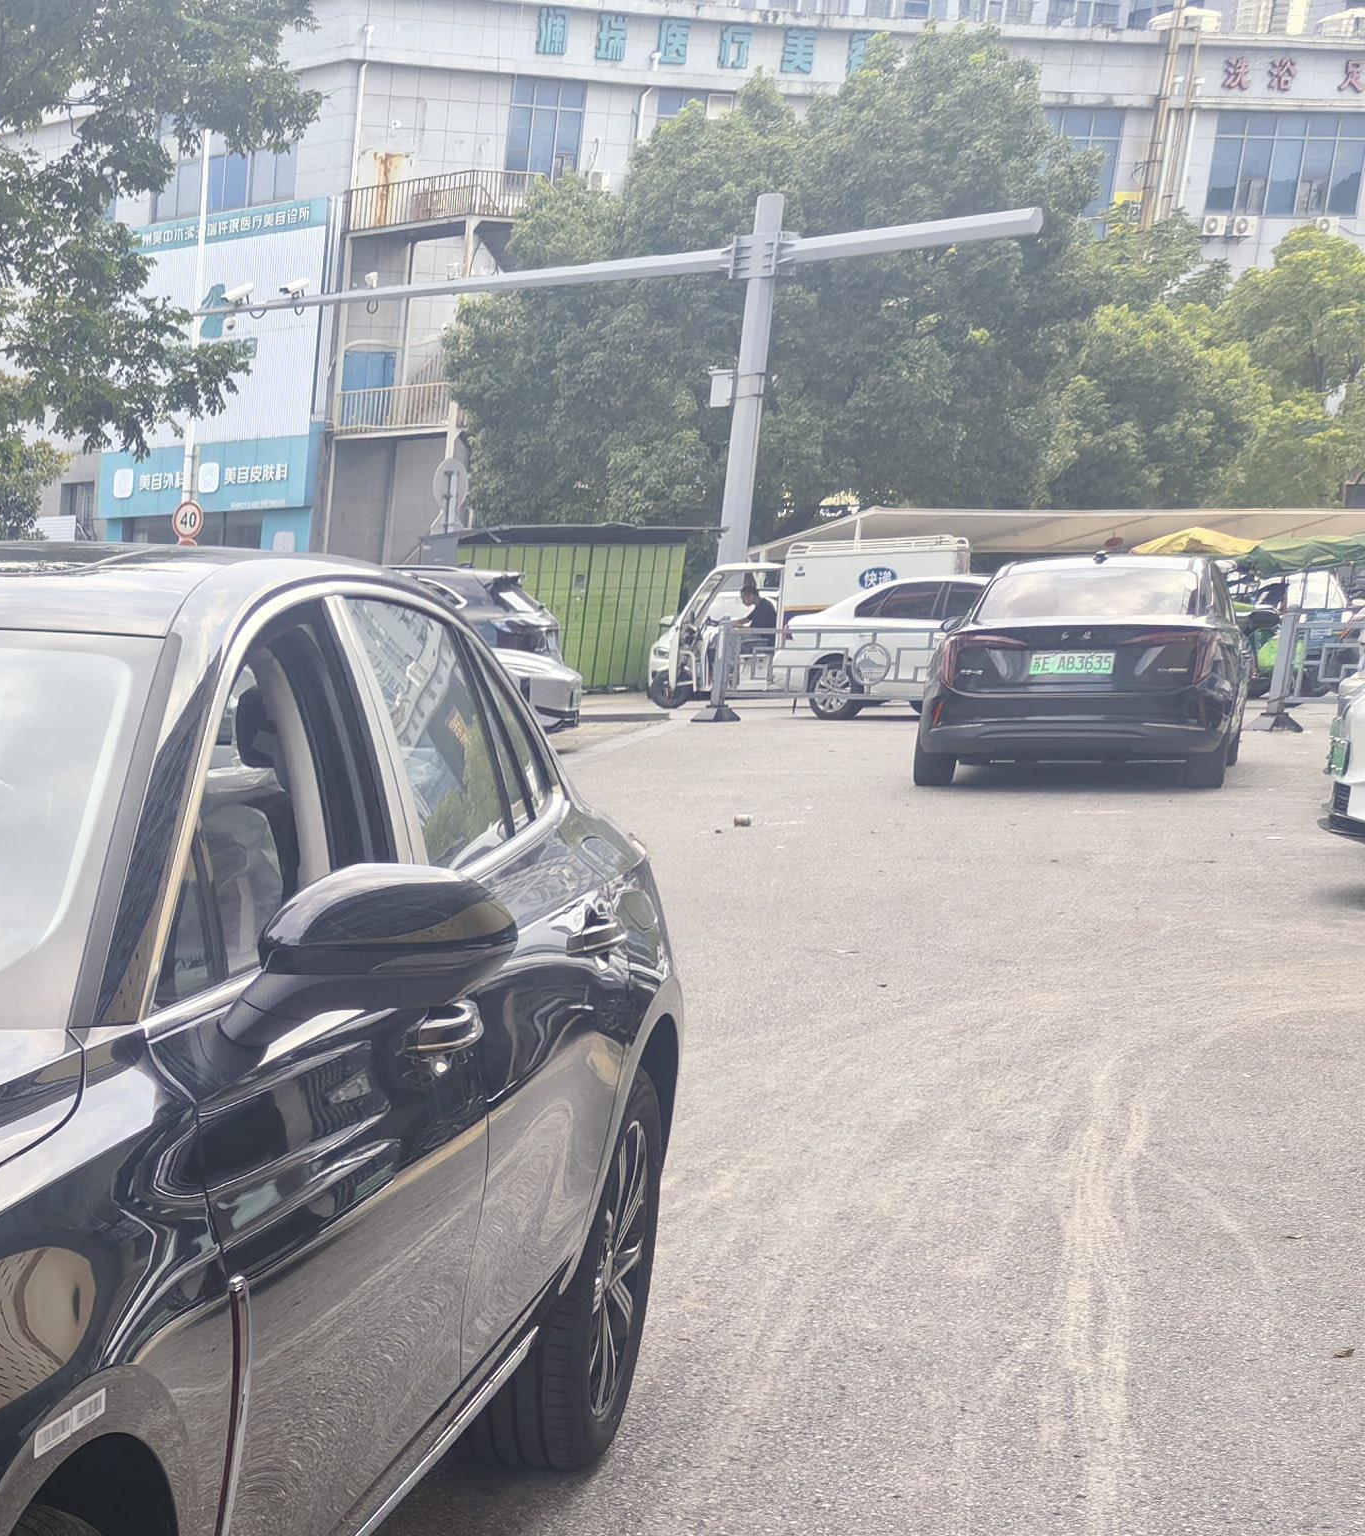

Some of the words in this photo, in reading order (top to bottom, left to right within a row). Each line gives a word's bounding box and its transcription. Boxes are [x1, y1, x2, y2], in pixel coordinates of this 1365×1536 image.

[1222, 56, 1297, 91] 洗浴
[224, 463, 288, 485] 美容皮肤科
[180, 511, 197, 528] 40
[864, 570, 893, 588] 快递
